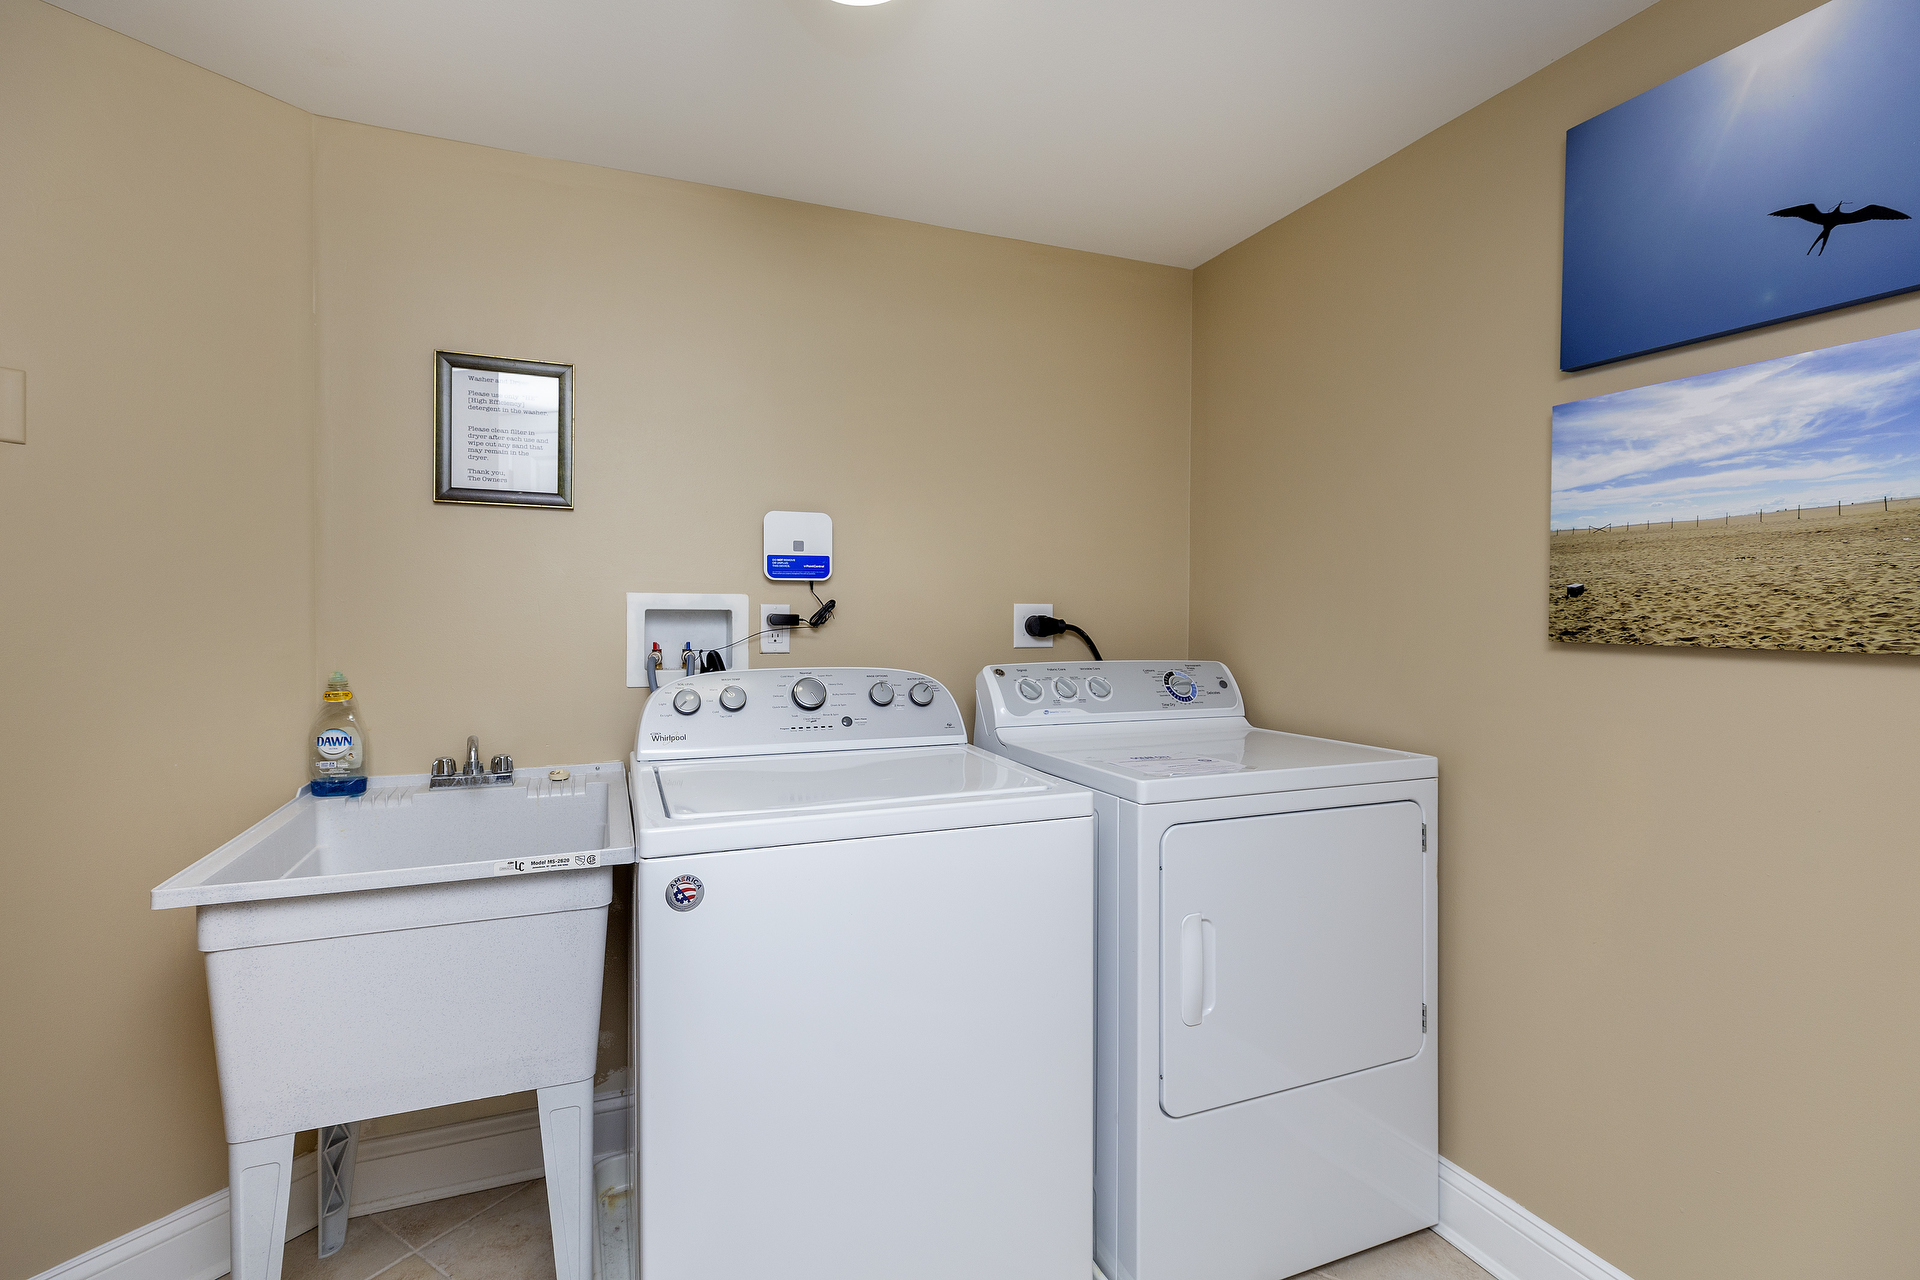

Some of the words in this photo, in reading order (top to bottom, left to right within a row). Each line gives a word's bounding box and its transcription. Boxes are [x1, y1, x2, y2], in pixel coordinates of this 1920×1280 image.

[468, 375, 494, 383] Washer
[316, 736, 352, 747] DAWN
[651, 734, 687, 742] Whirlpool
[670, 876, 702, 890] AMERICA
